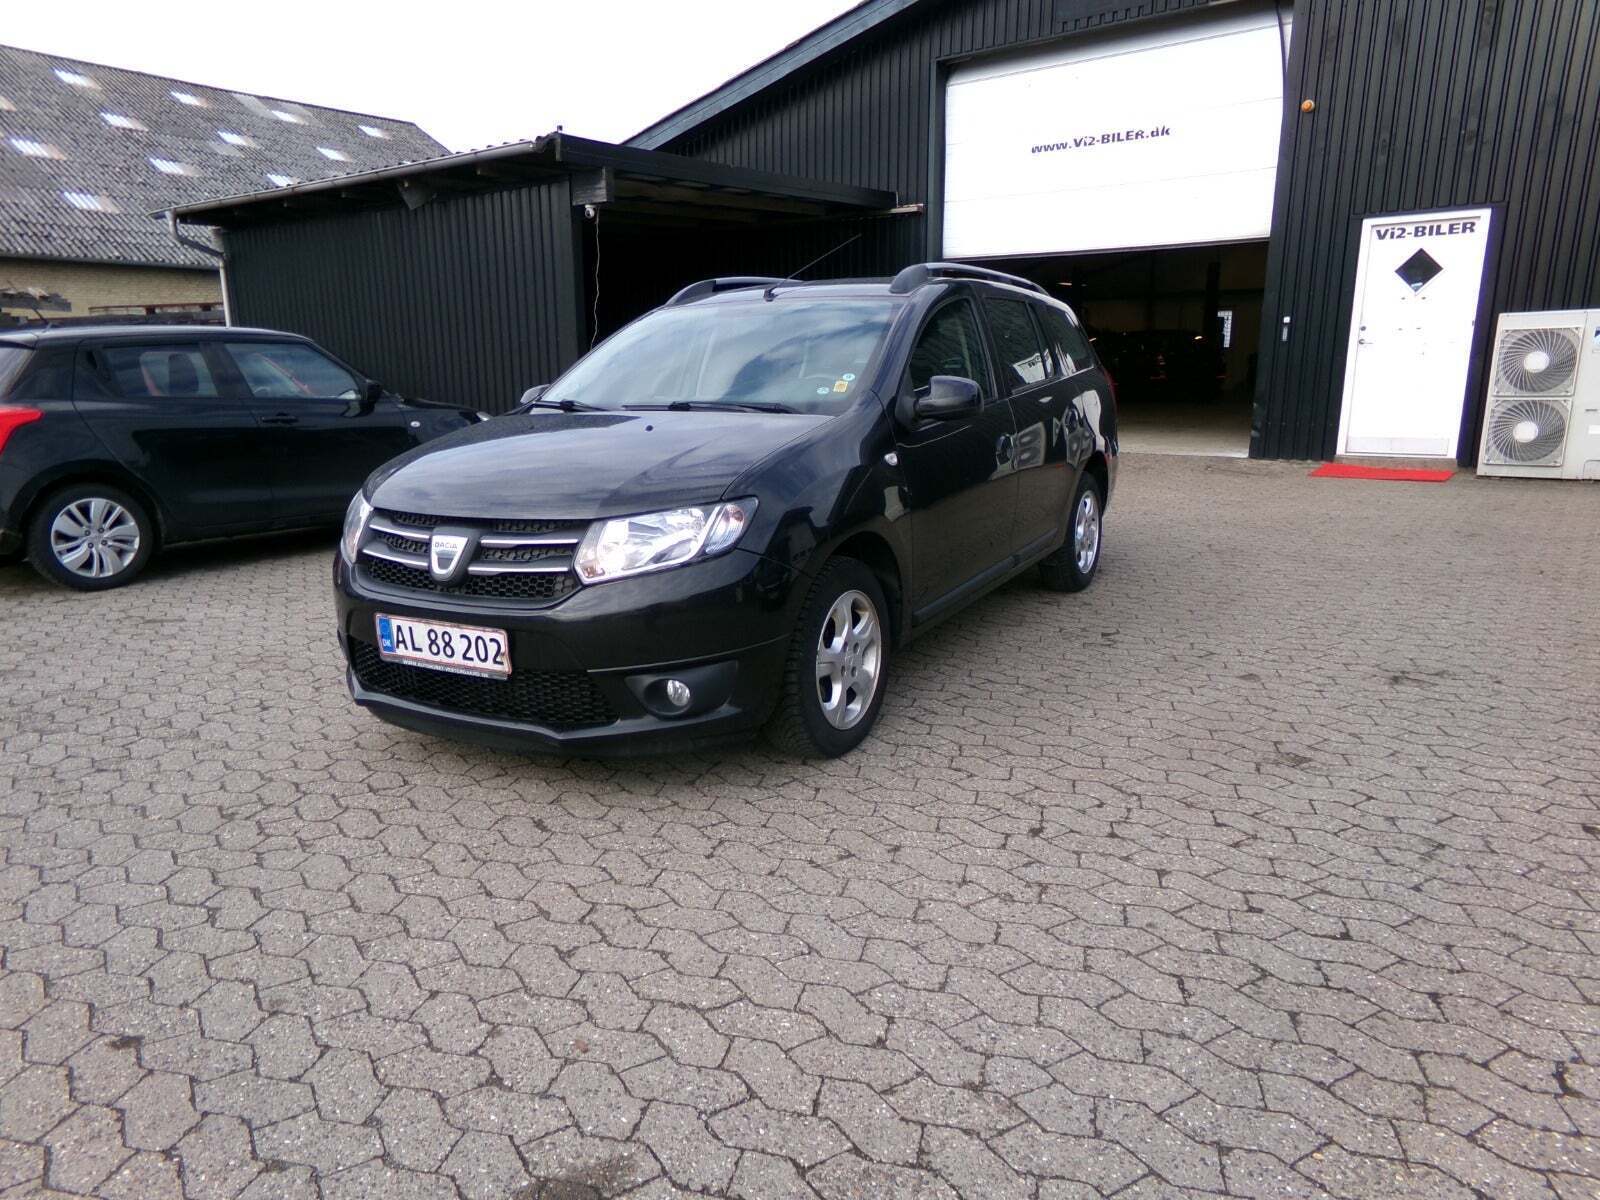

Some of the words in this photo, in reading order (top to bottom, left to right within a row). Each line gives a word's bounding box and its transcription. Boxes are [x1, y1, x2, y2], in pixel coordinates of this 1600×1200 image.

[1031, 125, 1171, 154] www.Vi2-BILER.dk
[1375, 221, 1476, 240] Vi2-BILER
[434, 541, 458, 550] DACIA
[395, 624, 423, 653] AL
[426, 628, 456, 659] 88
[459, 633, 505, 666] 202
